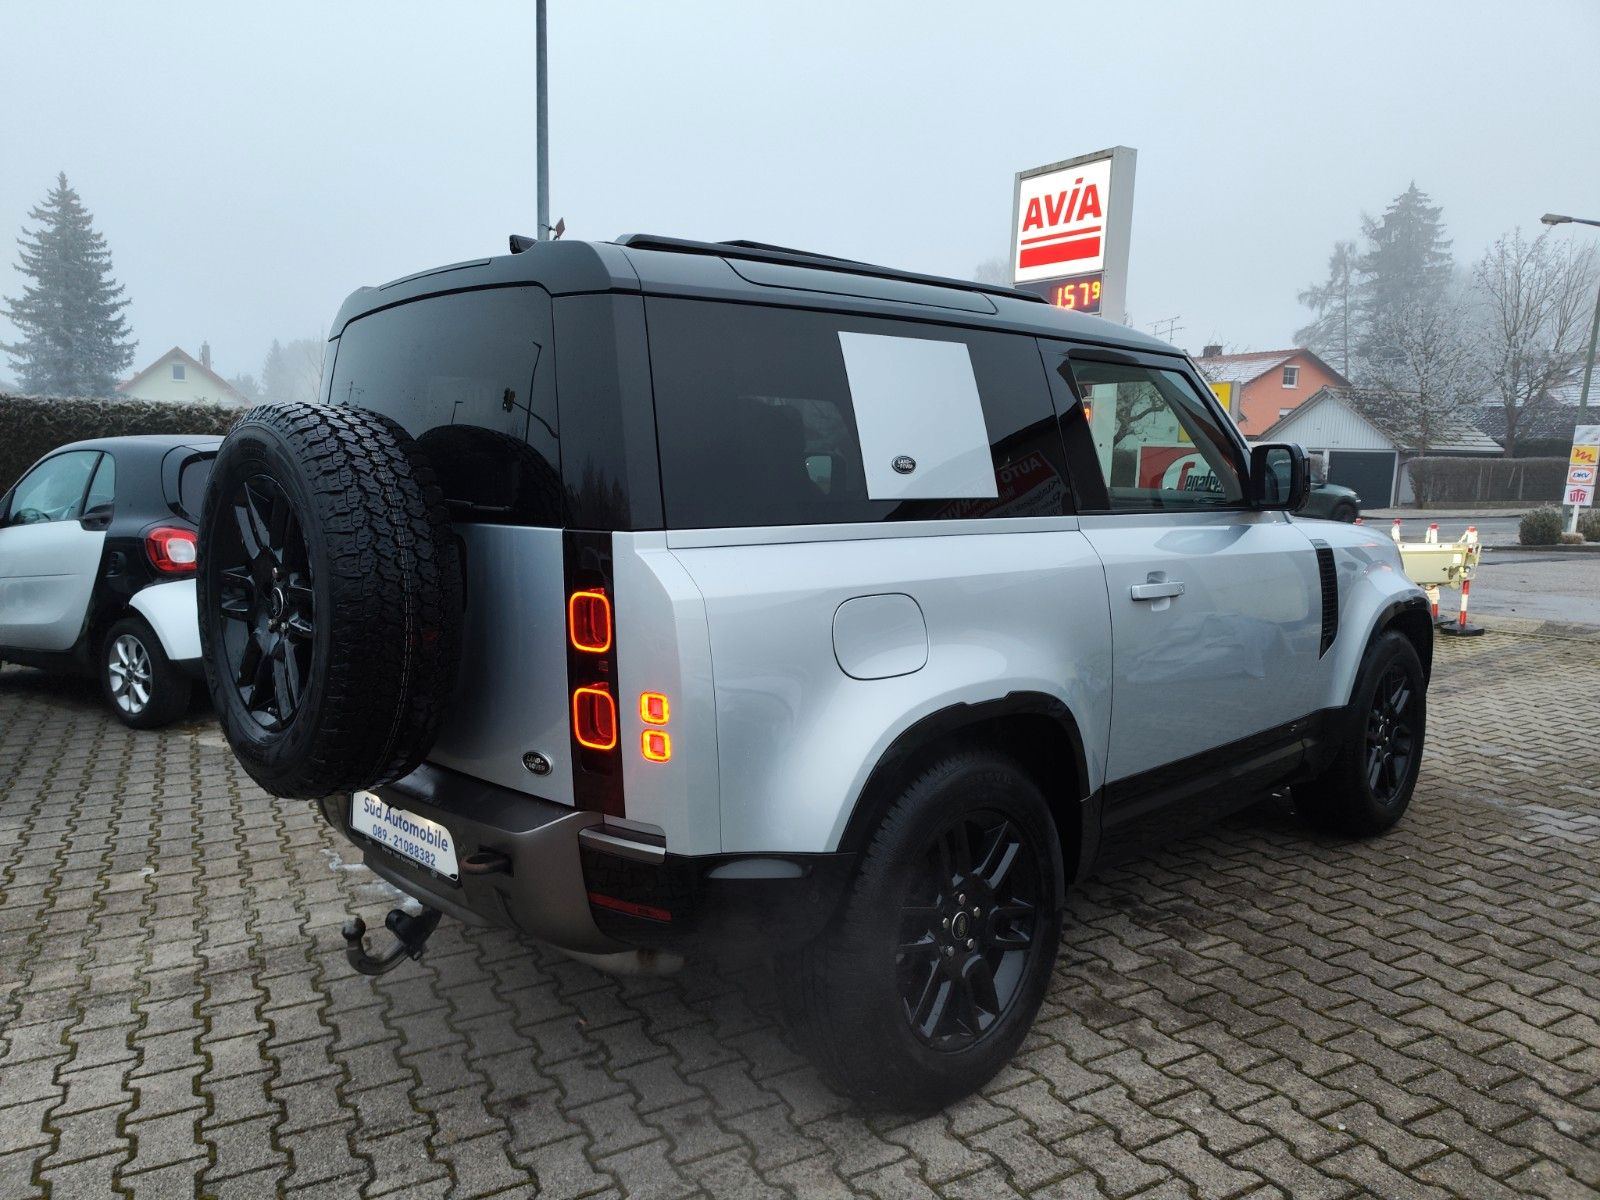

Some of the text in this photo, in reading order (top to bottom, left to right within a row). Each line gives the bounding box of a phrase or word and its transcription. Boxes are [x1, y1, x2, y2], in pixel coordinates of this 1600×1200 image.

[1022, 177, 1102, 232] AVIA
[1569, 488, 1588, 502] UTA
[363, 797, 449, 852] Süd Automobile
[372, 824, 388, 841] 089
[393, 835, 436, 867] 21088382
